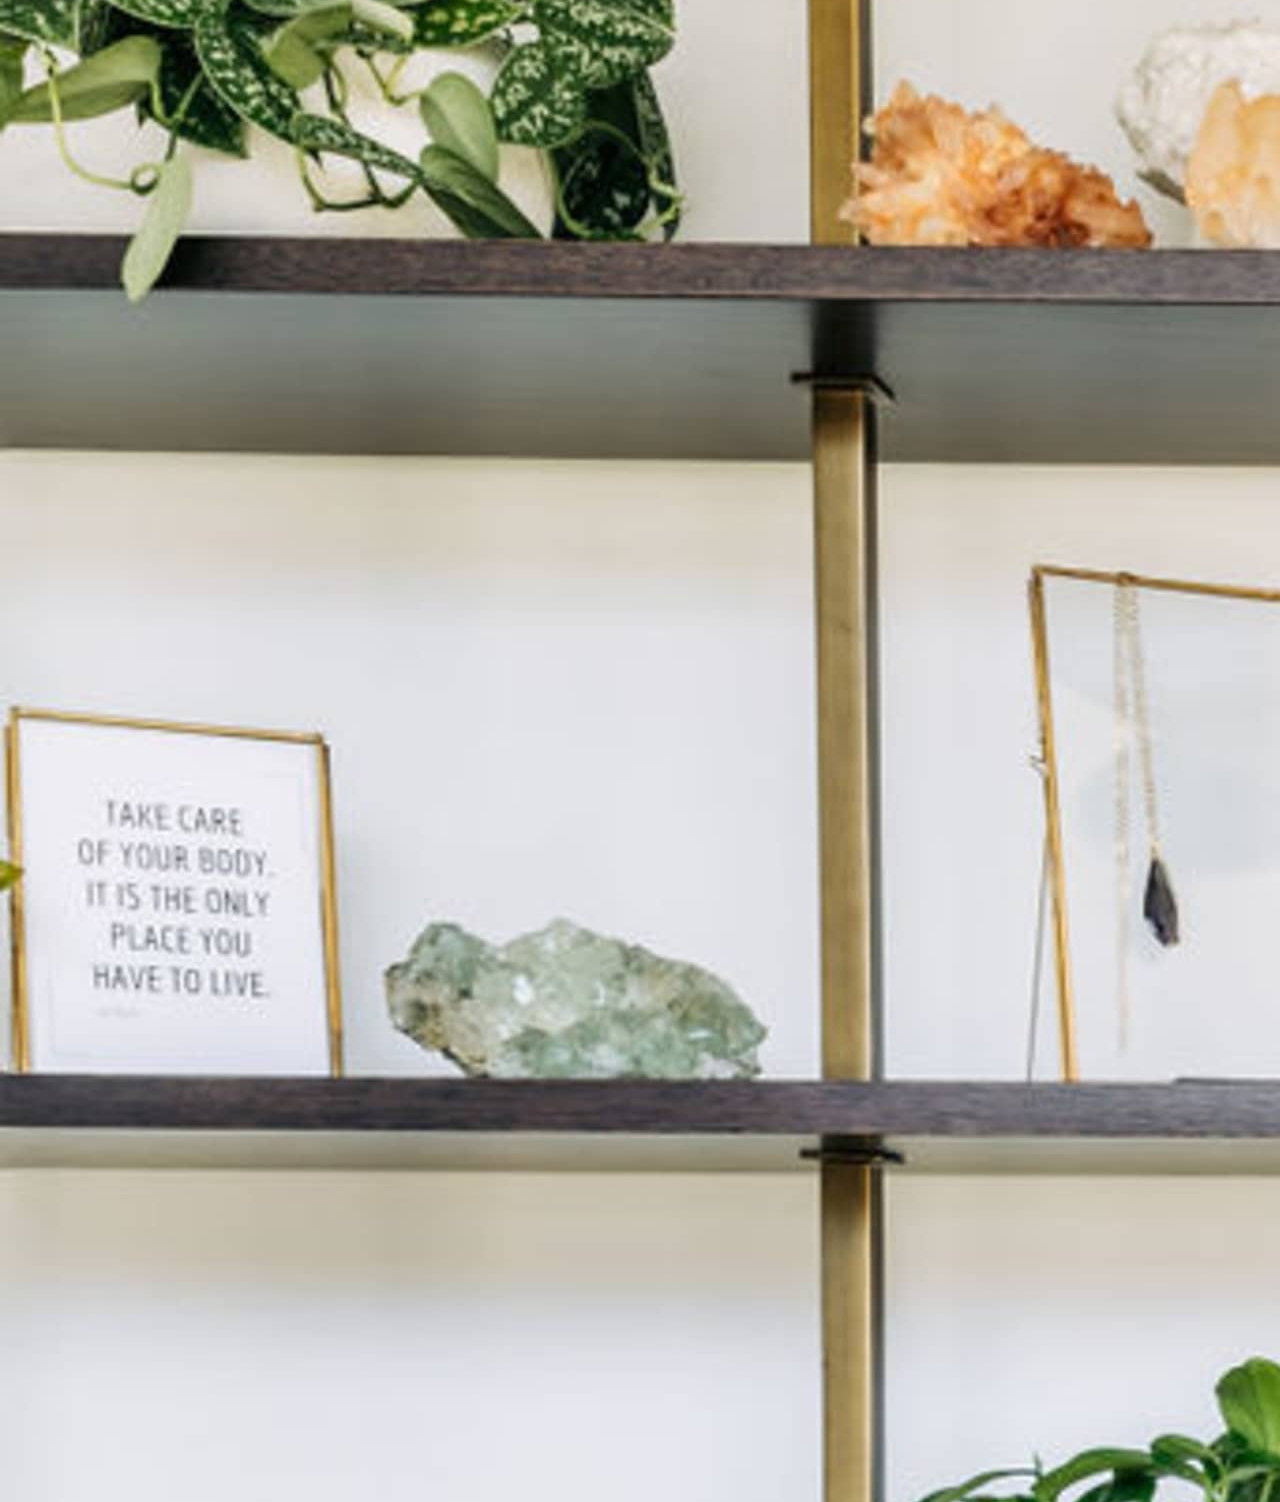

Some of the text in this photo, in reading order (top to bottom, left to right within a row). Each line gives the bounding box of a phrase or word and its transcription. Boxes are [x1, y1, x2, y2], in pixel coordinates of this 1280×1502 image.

[107, 800, 242, 836] TAKE CARE
[77, 837, 111, 865] OF
[119, 842, 190, 873] YOUR
[86, 881, 271, 918] IT IS THE ONLY
[111, 922, 252, 958] PLACE YOU
[93, 964, 161, 993] HAVE
[171, 967, 201, 996] TO
